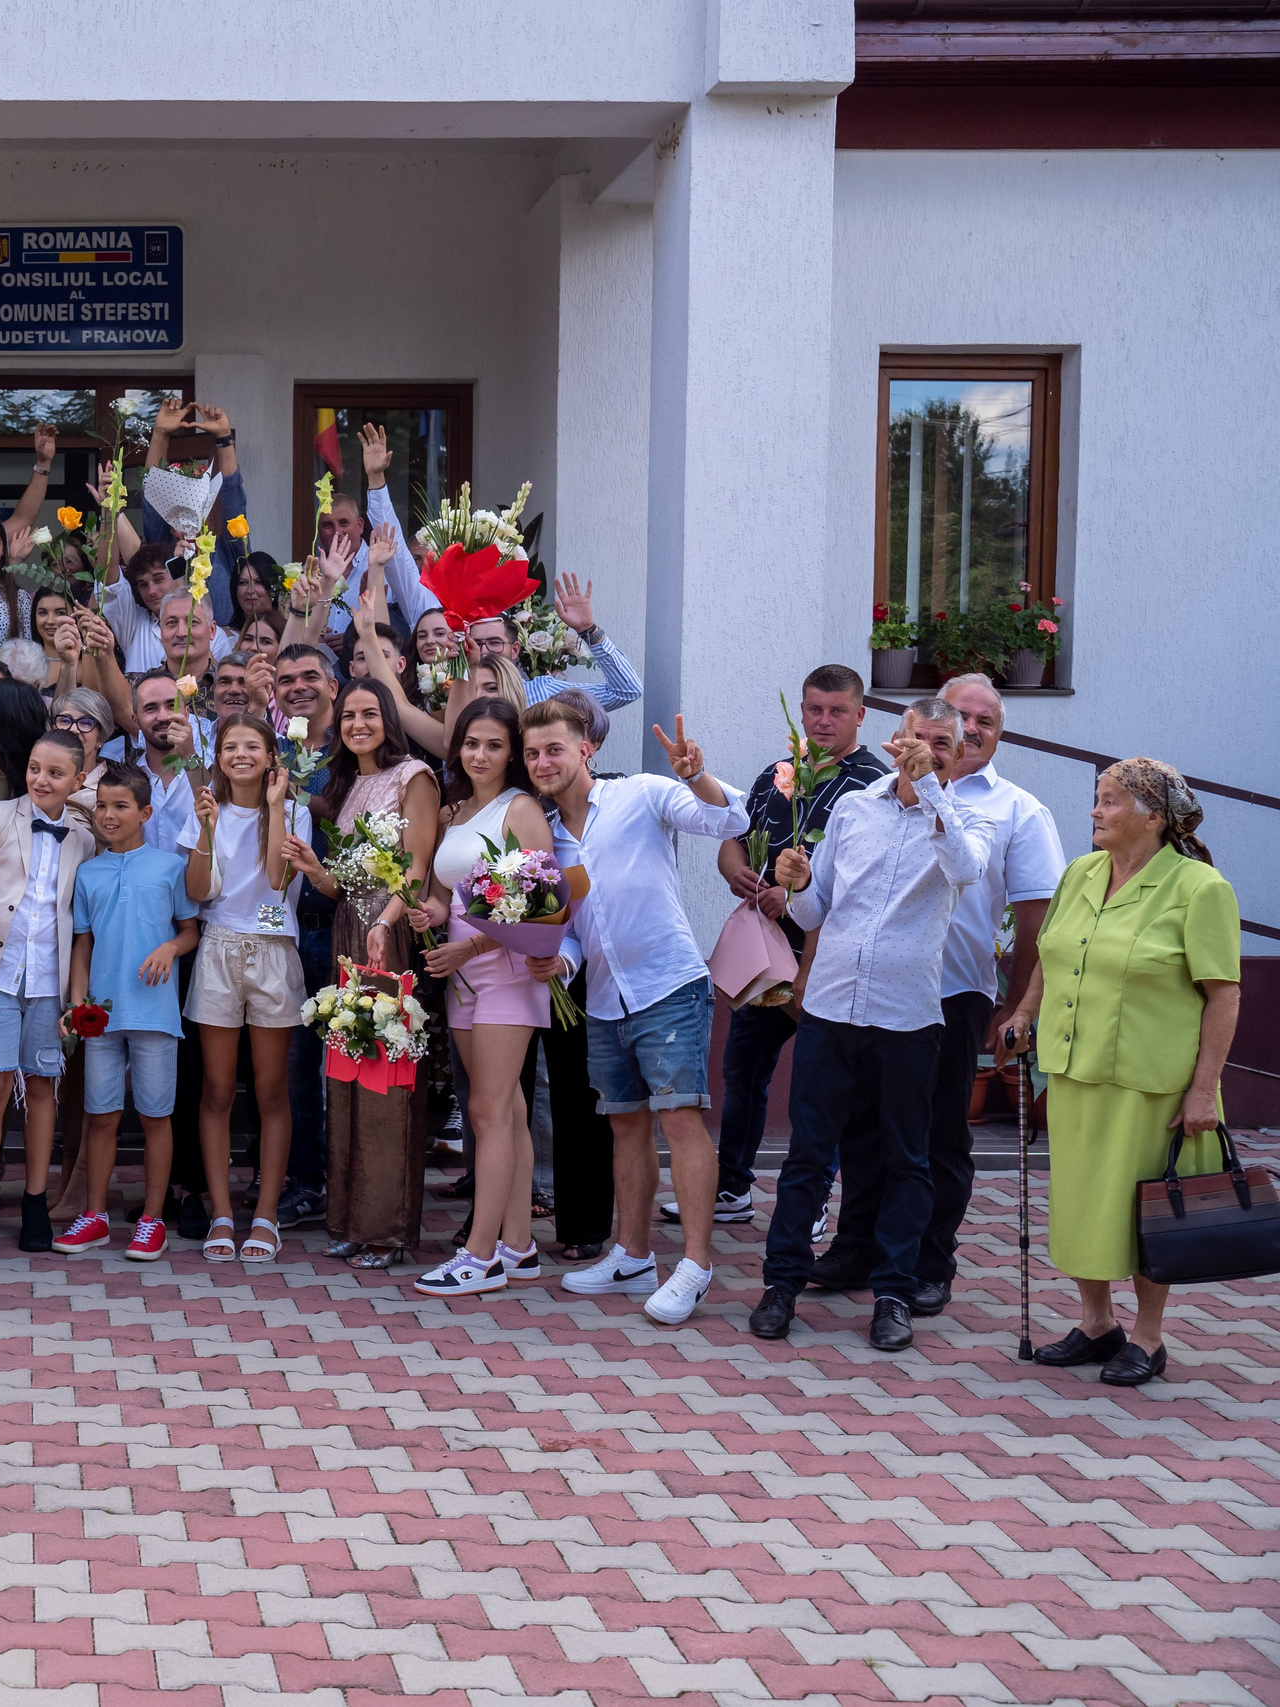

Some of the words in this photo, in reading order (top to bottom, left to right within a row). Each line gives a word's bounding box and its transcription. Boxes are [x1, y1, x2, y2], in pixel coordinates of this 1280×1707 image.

[22, 231, 133, 249] ROMANIA
[102, 271, 169, 286] LOCAL
[69, 290, 86, 300] AL
[80, 302, 169, 322] STEFESTI
[81, 329, 169, 344] PRAHOVA
